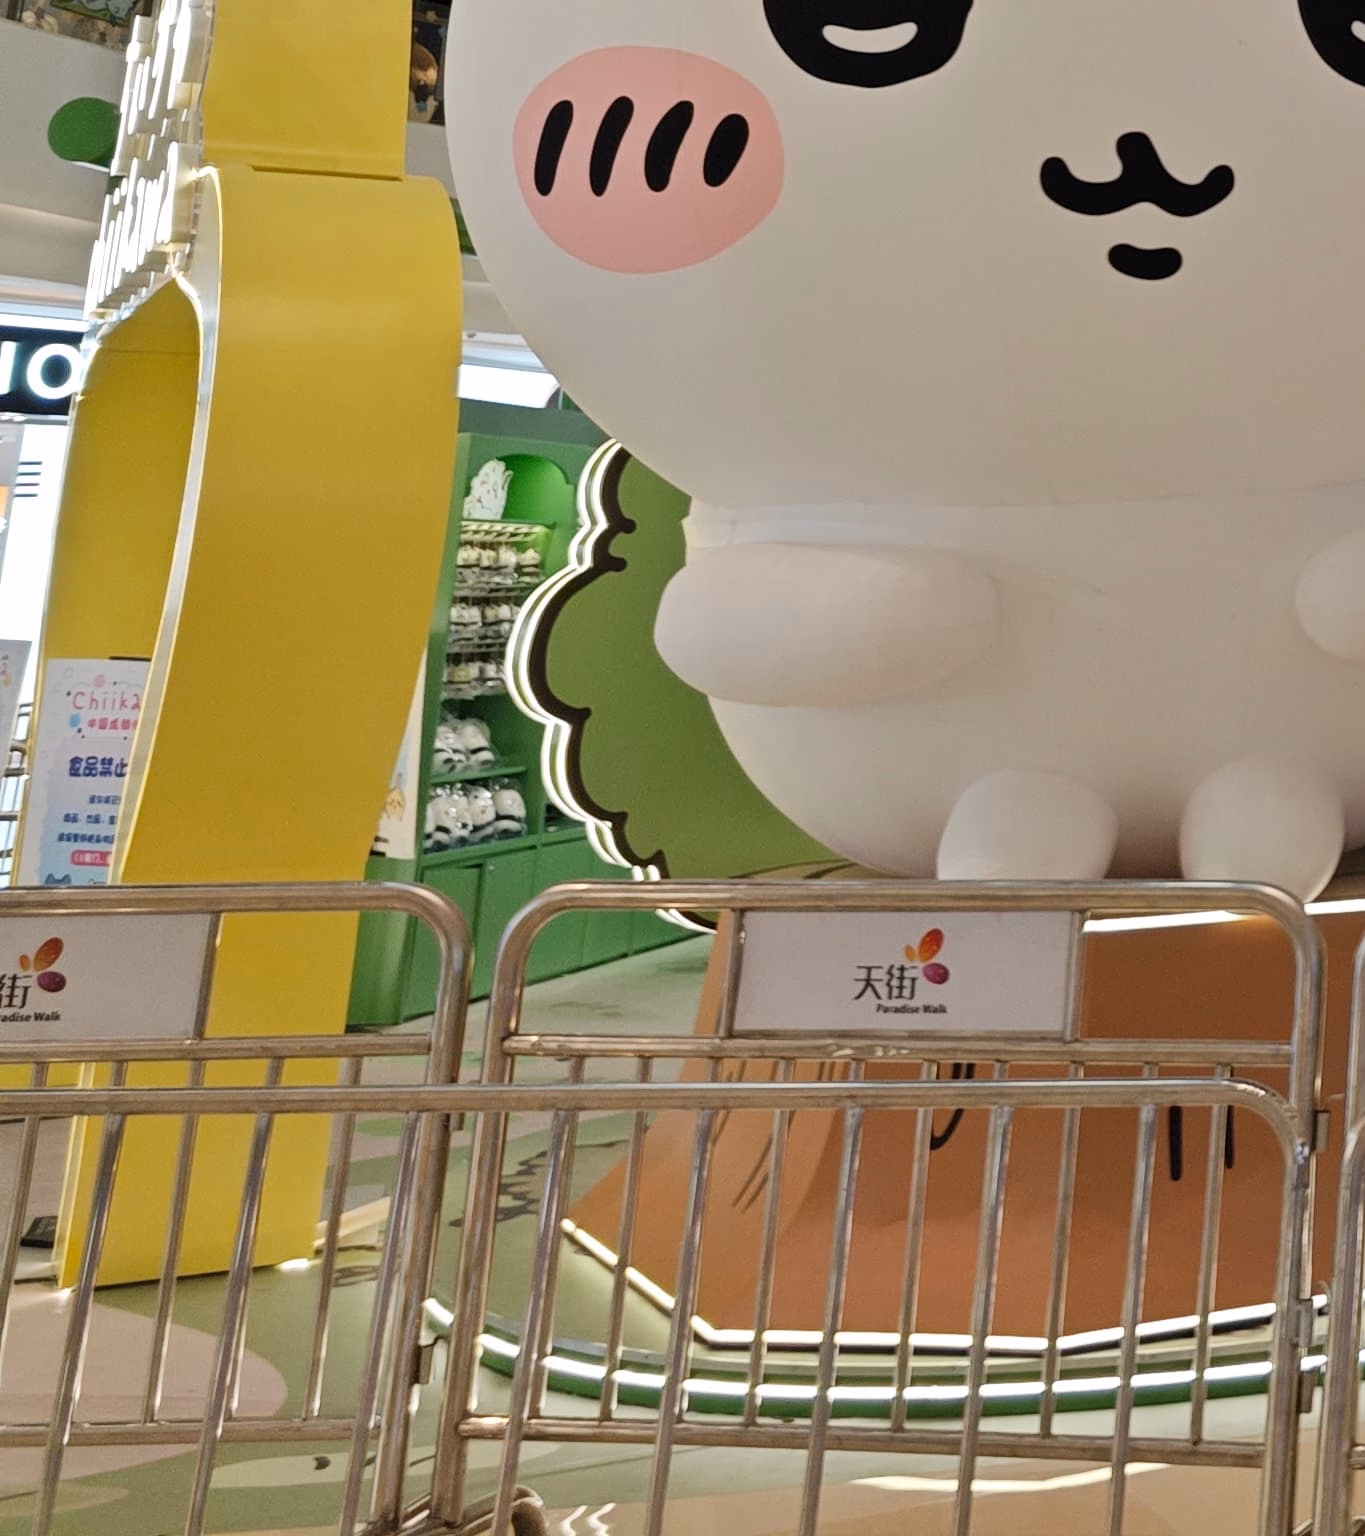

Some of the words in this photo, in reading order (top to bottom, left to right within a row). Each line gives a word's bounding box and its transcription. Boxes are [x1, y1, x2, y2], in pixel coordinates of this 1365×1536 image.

[853, 964, 918, 1000] 天街
[876, 1003, 920, 1014] Paradise
[923, 1003, 948, 1014] Walk
[34, 1011, 61, 1022] Walk
